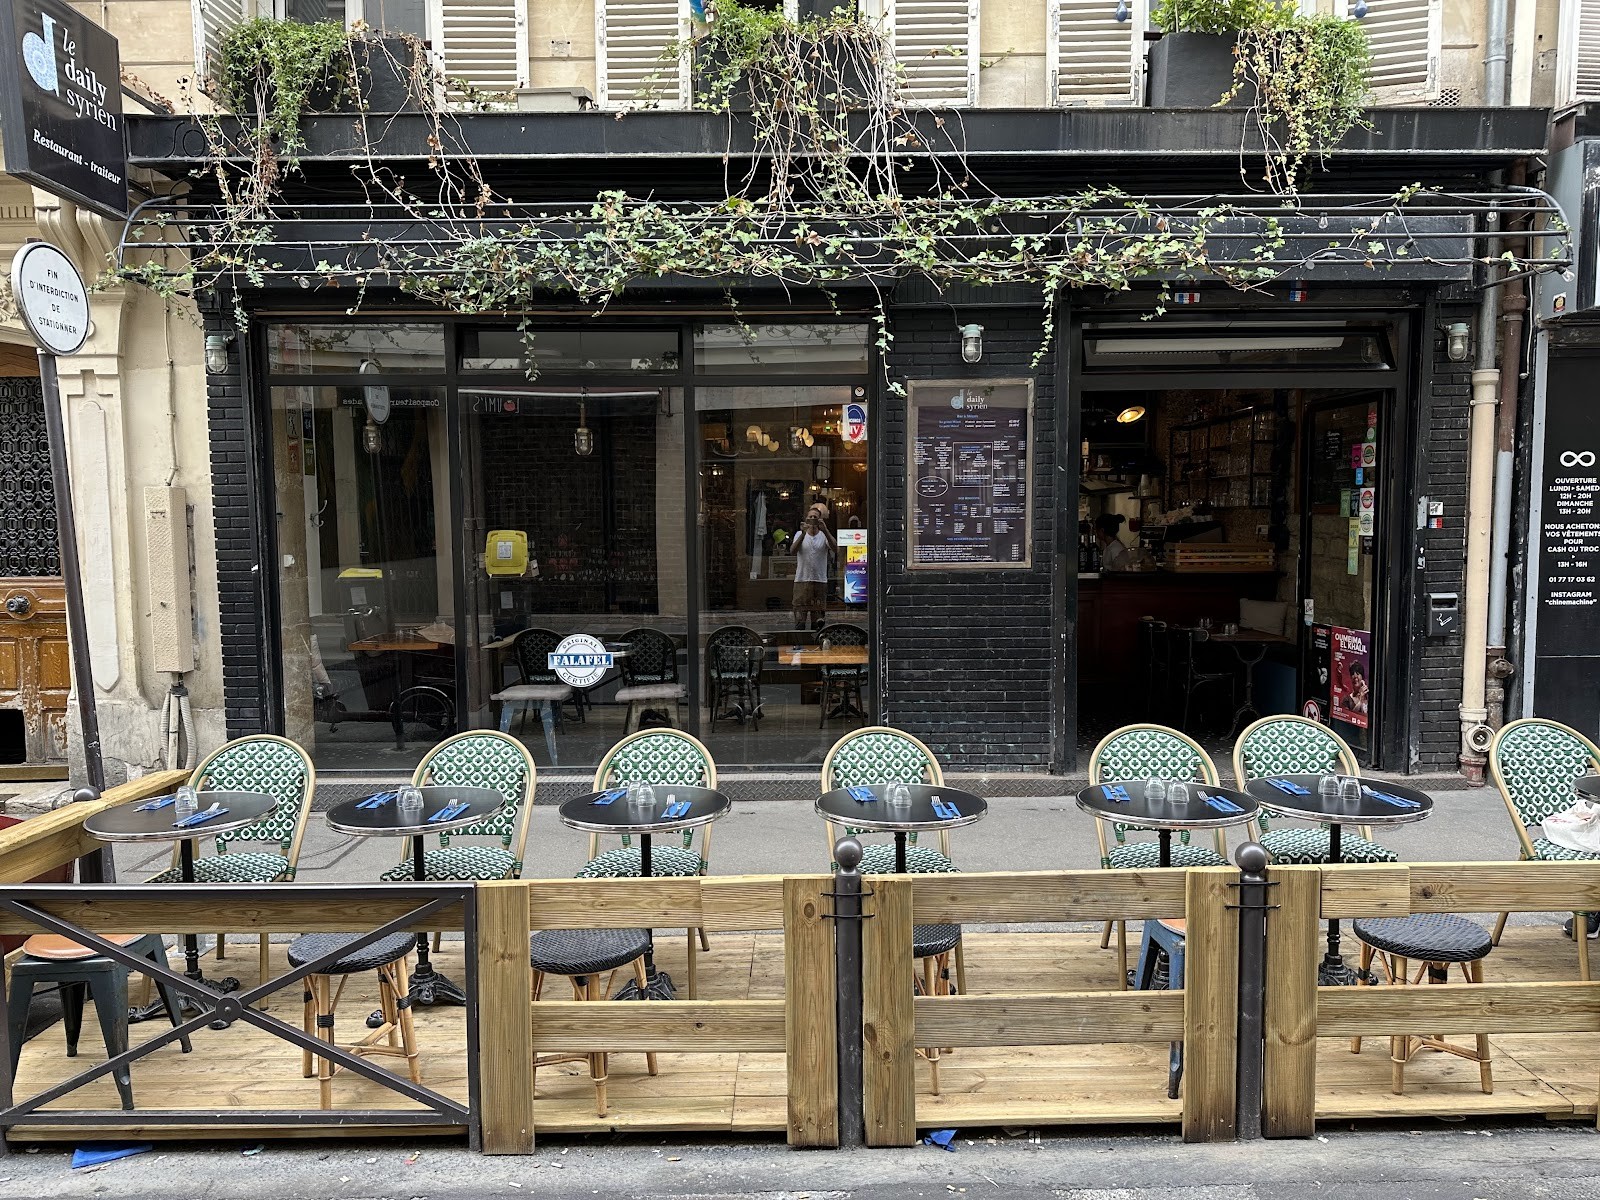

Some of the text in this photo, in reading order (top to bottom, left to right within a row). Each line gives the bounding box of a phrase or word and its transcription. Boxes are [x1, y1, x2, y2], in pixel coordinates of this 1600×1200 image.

[63, 27, 76, 56] le
[65, 57, 107, 106] daily
[66, 88, 117, 132] syrien
[33, 129, 82, 165] Restaurant
[90, 161, 121, 185] traiteur
[47, 269, 58, 280] FIN
[29, 280, 79, 303] D'INTERDICTION
[51, 303, 61, 314] DE
[38, 316, 77, 335] STATIONNER
[966, 396, 985, 405] daily
[966, 403, 988, 412] syrien
[562, 638, 598, 649] ORIGINAL
[1340, 641, 1347, 649] EL
[1348, 642, 1367, 654] KHALIL
[552, 654, 610, 666] FALAFEL
